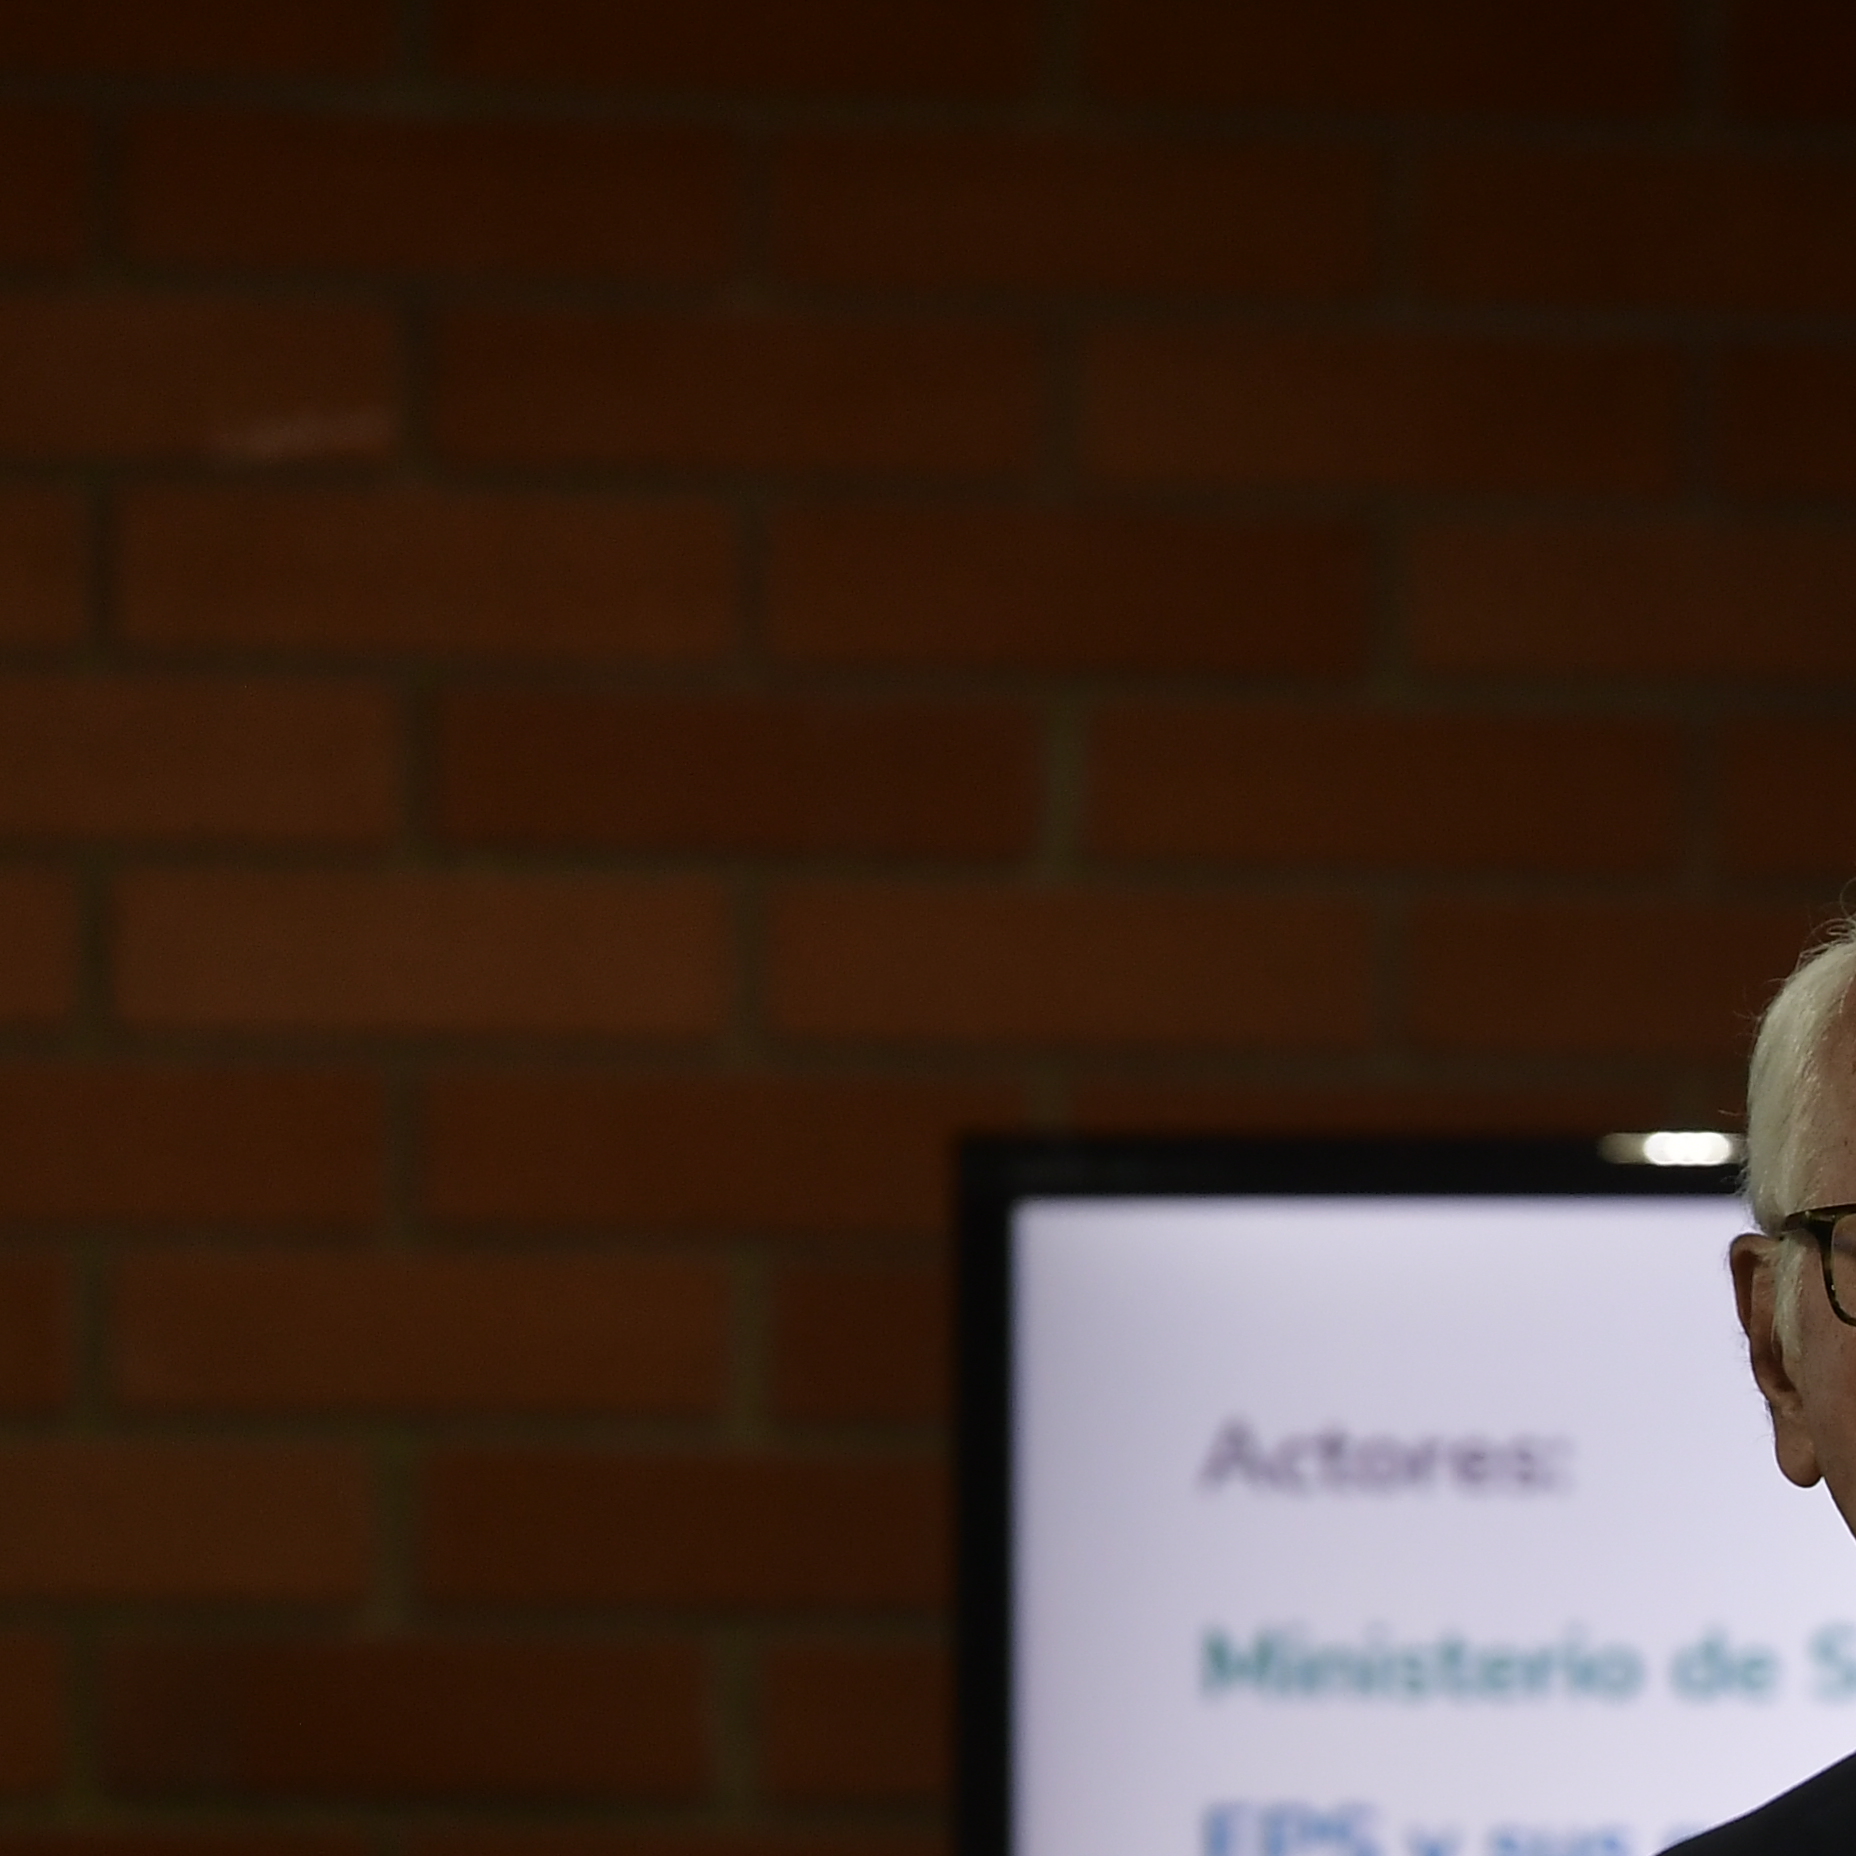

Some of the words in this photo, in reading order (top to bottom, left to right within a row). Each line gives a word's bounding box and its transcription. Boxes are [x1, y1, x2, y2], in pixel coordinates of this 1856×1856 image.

[1200, 1413, 1572, 1489] Actores:
[1200, 1618, 1645, 1702] Ministerio
[1667, 1623, 1782, 1704] de
